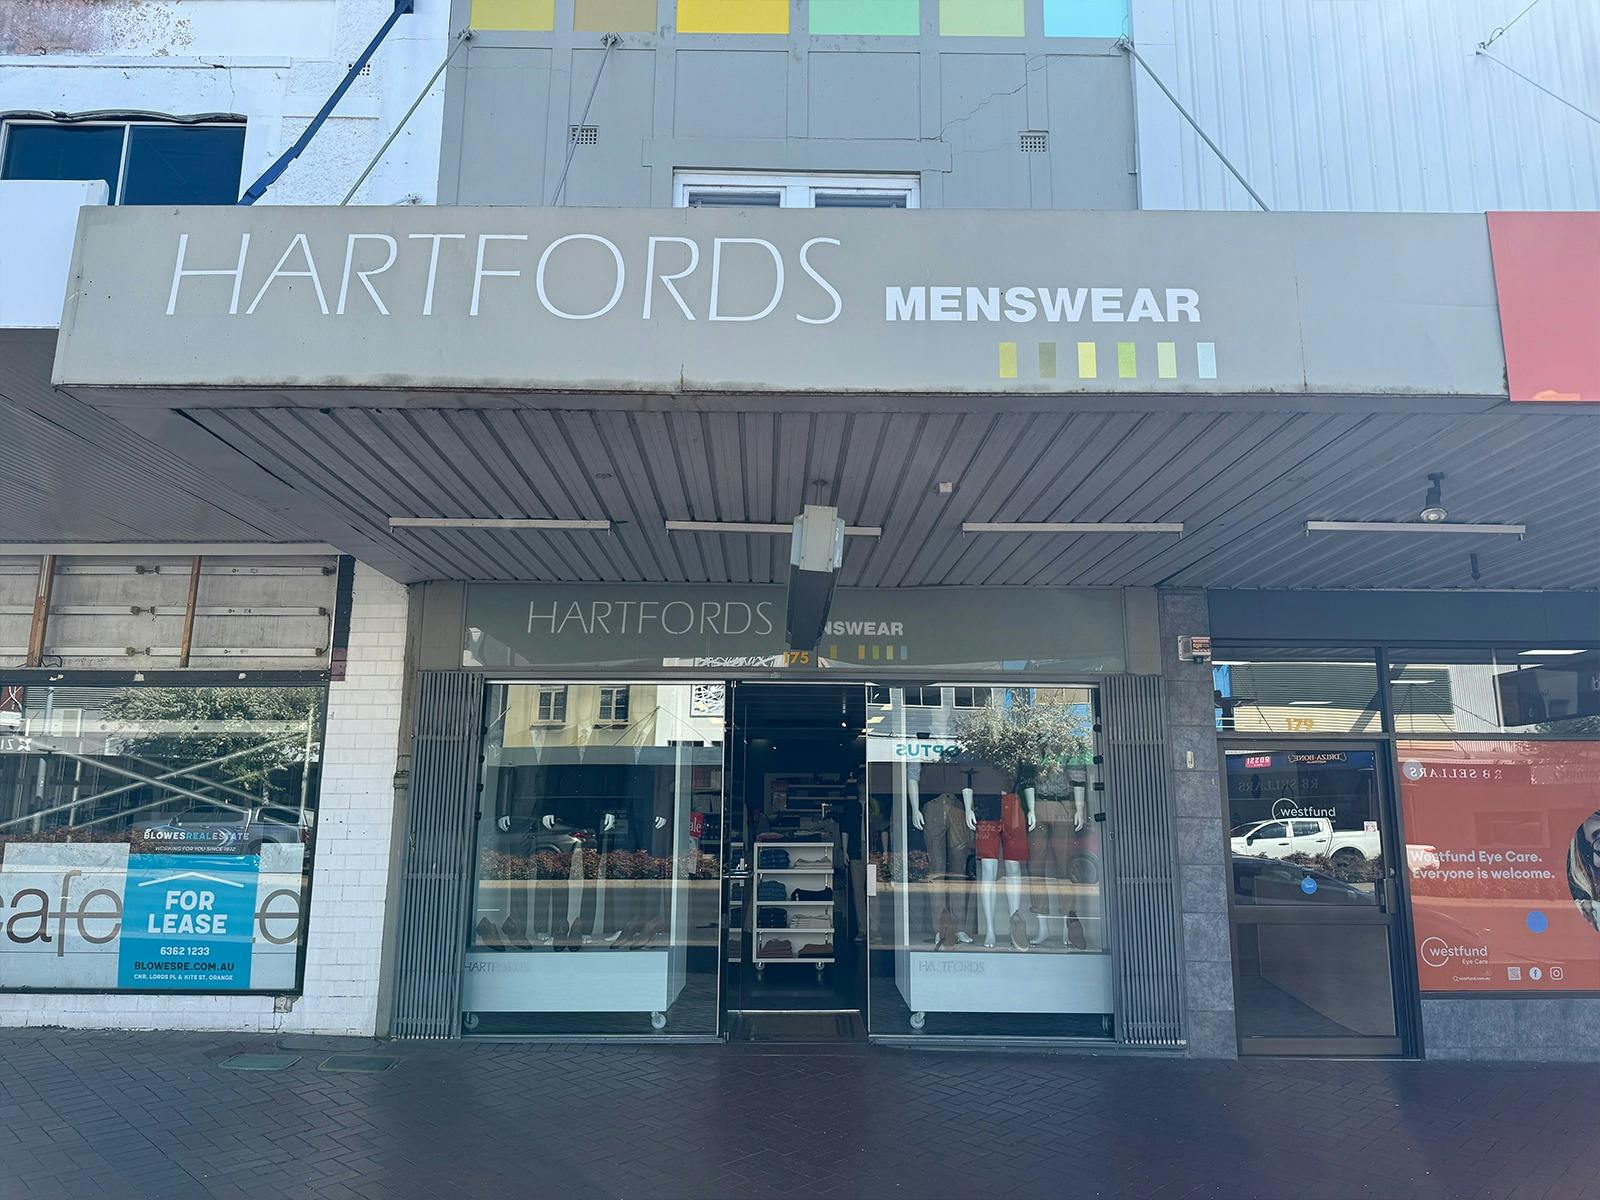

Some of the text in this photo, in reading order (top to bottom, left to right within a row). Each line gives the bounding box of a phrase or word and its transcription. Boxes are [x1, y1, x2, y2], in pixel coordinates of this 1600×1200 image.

[165, 233, 1201, 325] HARTFORDS MENSWEAR
[527, 600, 904, 636] HARTFORDS NSWEAR
[783, 650, 810, 665] 175
[1286, 717, 1314, 732] 179
[1280, 806, 1336, 817] westfund
[1411, 850, 1543, 865] Westfund Eye Care.
[1413, 866, 1556, 882] Everyone is welcome.
[165, 890, 215, 911] FOR
[0, 869, 123, 957] afe
[147, 913, 228, 934] LEASE
[160, 946, 210, 956] 6362 1233
[1429, 945, 1488, 957] westfund
[134, 961, 235, 972] BLOWESRE.COM.AU
[149, 973, 169, 981] LORDS
[169, 973, 177, 981] PL
